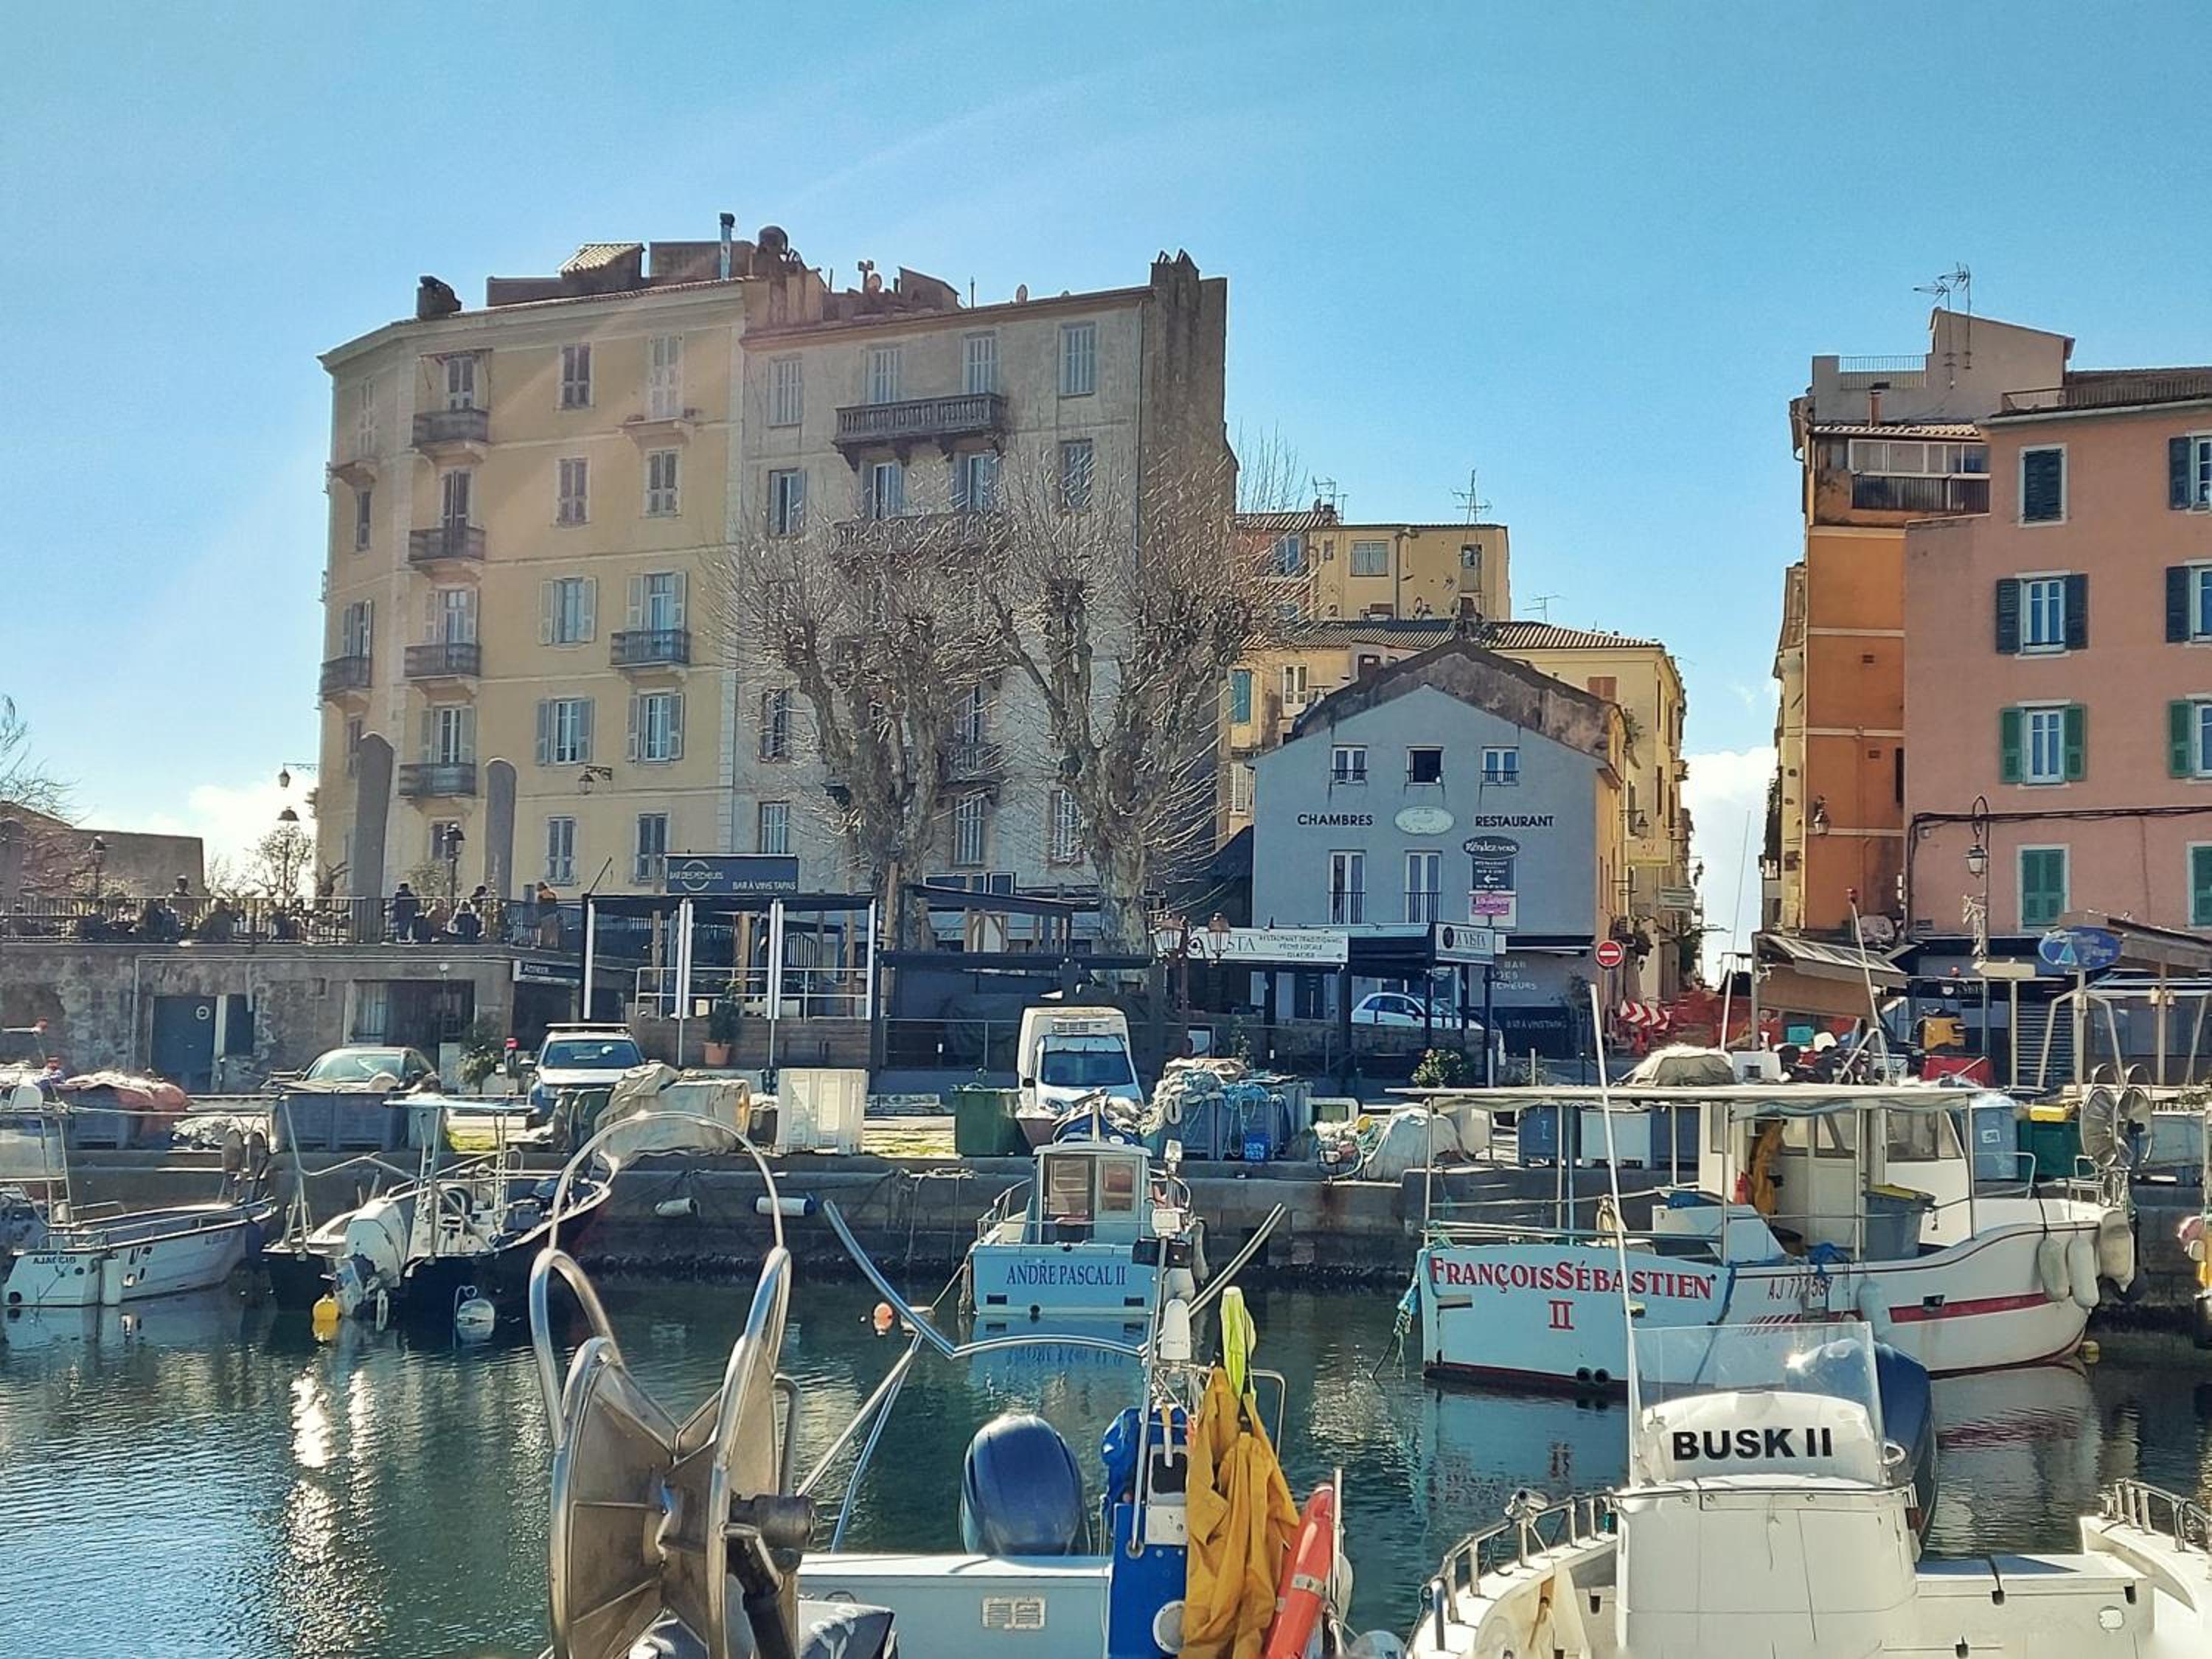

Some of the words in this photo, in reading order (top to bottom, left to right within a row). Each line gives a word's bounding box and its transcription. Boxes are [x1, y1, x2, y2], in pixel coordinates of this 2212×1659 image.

[1298, 814, 1373, 826] CHAMBRES
[1475, 815, 1554, 827] RESTAURANT
[1060, 1265, 1113, 1285] PASCAL
[1116, 1265, 1127, 1286] II
[1767, 1278, 1785, 1299] AJ
[1549, 1300, 1574, 1330] II
[1672, 1428, 1796, 1461] BUSK
[1806, 1427, 1833, 1457] II
